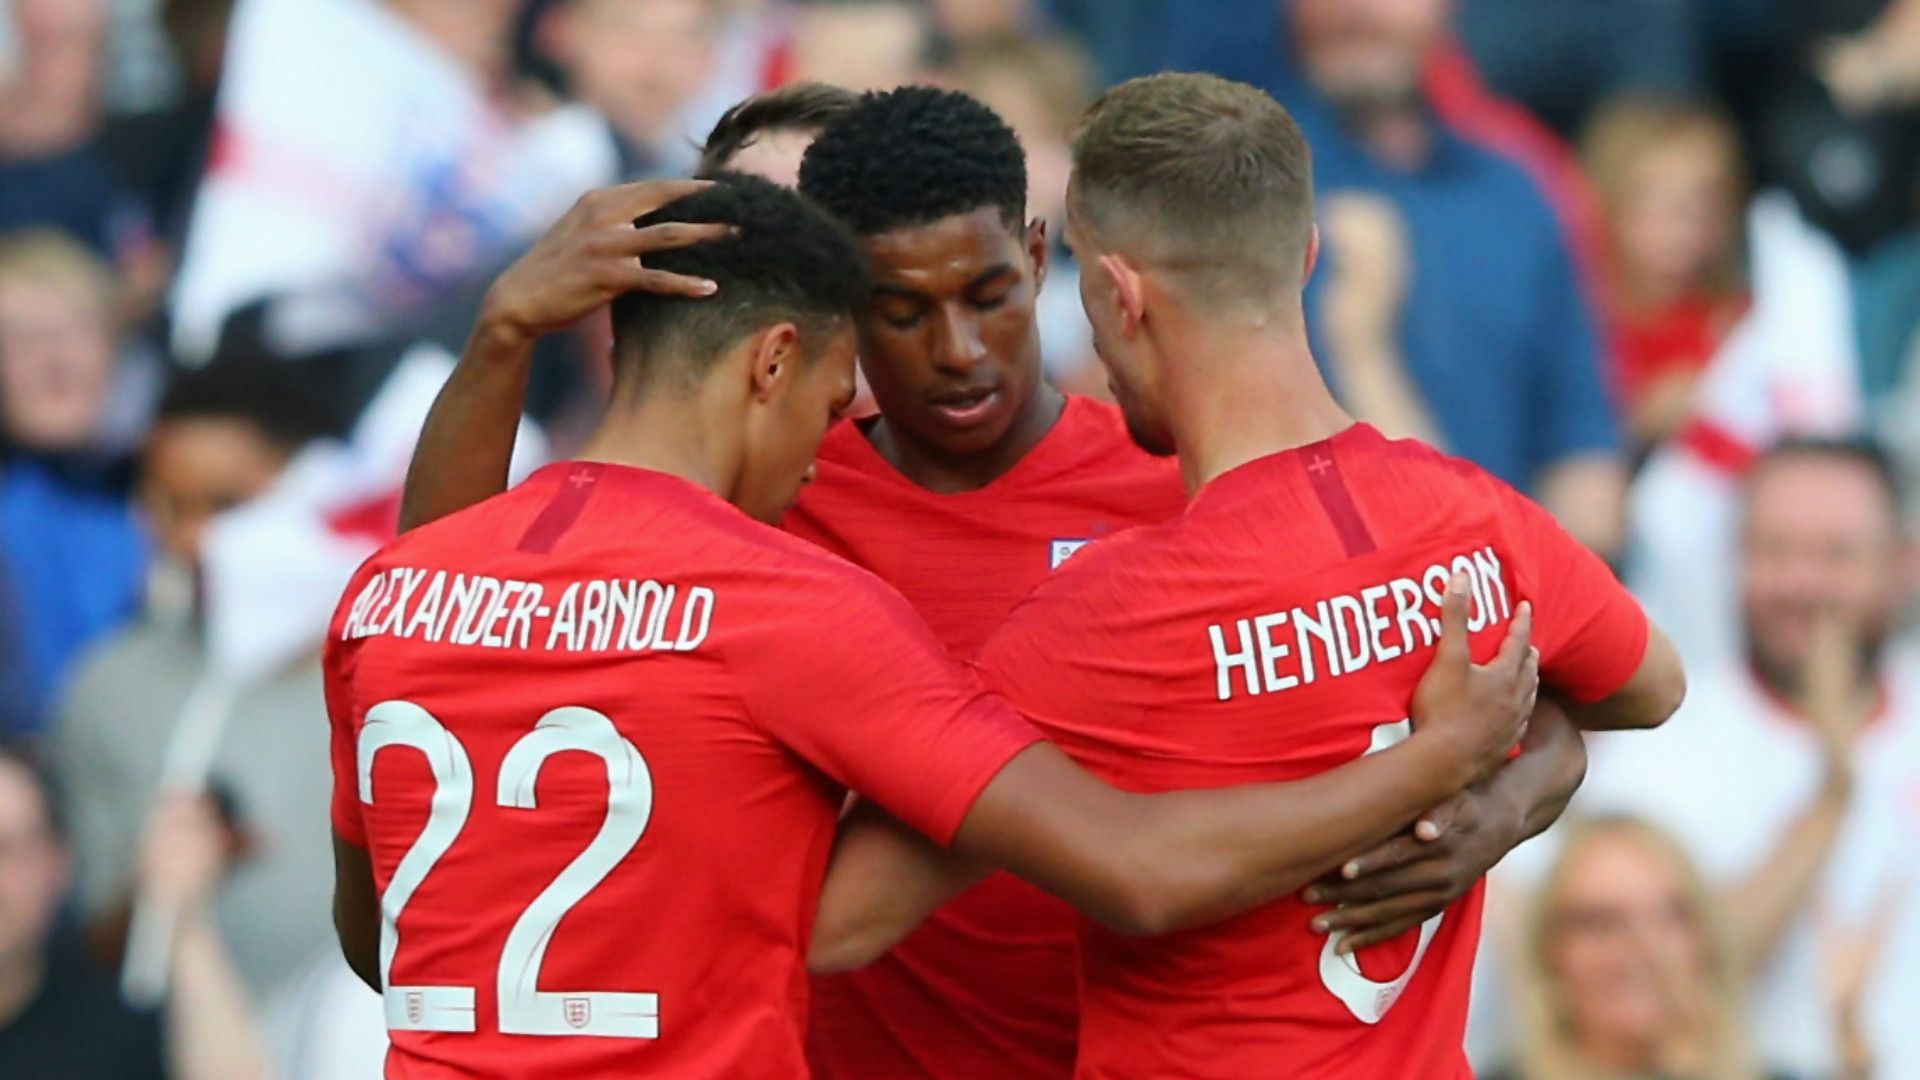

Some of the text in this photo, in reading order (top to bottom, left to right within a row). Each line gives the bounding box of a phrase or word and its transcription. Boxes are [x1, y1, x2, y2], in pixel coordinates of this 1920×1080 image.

[341, 566, 716, 652] ALEXANDER-ARNOLD
[1208, 547, 1511, 701] HENDERSON
[357, 700, 659, 1039] 22
